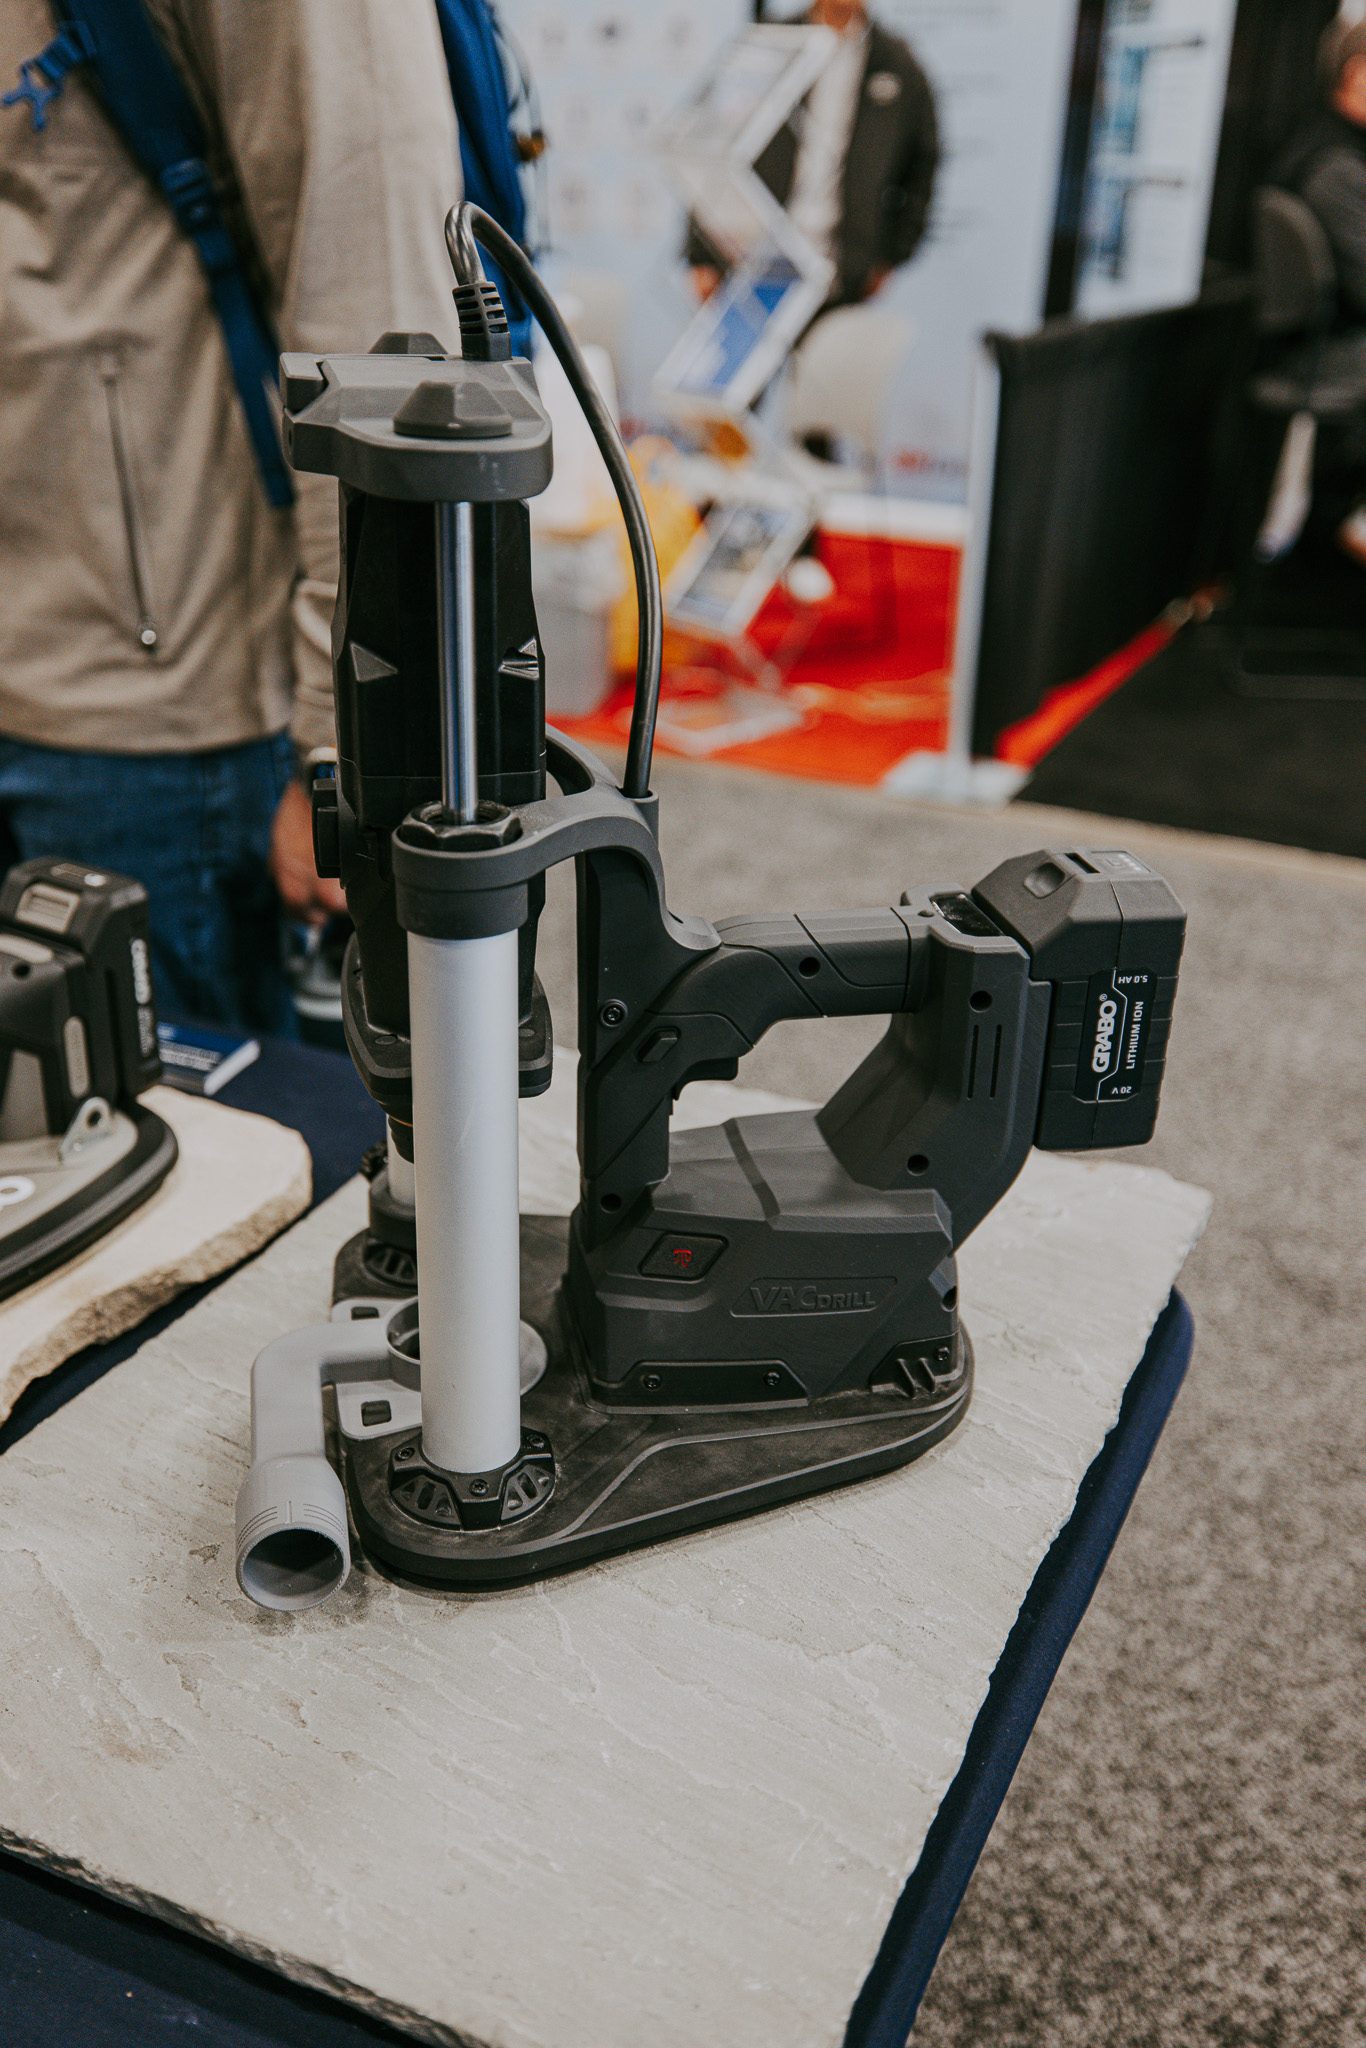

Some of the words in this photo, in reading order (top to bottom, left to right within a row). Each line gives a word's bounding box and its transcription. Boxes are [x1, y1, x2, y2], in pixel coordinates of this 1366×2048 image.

[1118, 976, 1132, 984] AH
[1134, 974, 1149, 984] 5.0
[1133, 1001, 1144, 1021] ION
[1126, 1023, 1141, 1070] LITHIUM
[1120, 1086, 1132, 1094] 20
